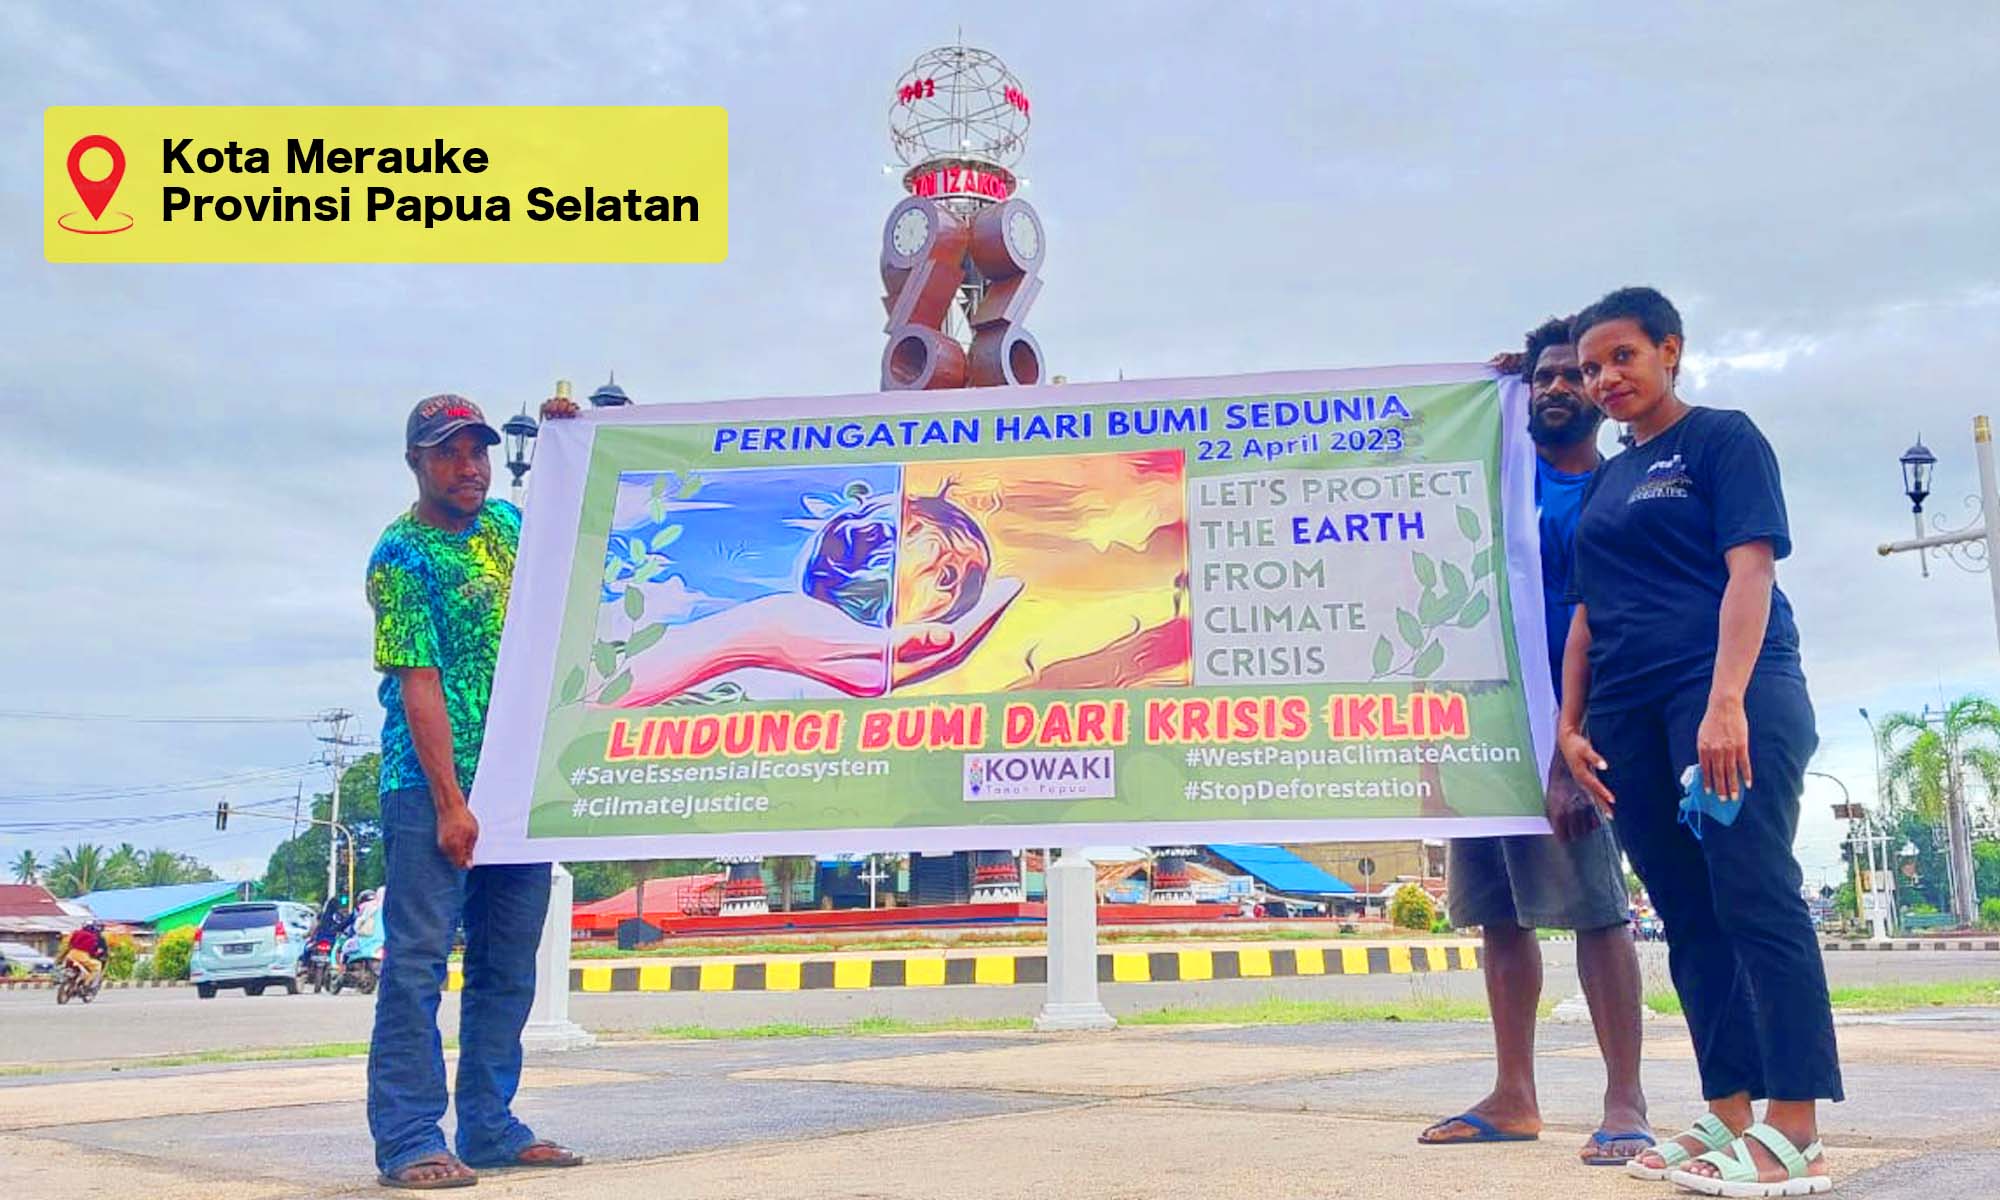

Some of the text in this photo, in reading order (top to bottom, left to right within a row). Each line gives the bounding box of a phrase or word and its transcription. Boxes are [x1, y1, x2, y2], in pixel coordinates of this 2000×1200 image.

[713, 394, 1411, 453] PERINGATAN HARI BUMI SEDUNIA
[1197, 428, 1404, 462] 22 April 2023
[1200, 470, 1472, 506] LET'S PROTECT
[1200, 511, 1425, 549] THE EARTH
[1203, 559, 1326, 592] FROM
[1204, 602, 1366, 633] CLIMATE
[1206, 646, 1326, 677] CRISIS
[606, 693, 1471, 760] LINDUNGI BUMI DARI KRISIS IKLIM
[570, 757, 890, 787] #SaveEssensialEcosystem
[985, 757, 1111, 782] KOWAKI
[1185, 743, 1521, 769] #WestPapuaClimateAction
[1184, 779, 1431, 805] #StopDeforestation
